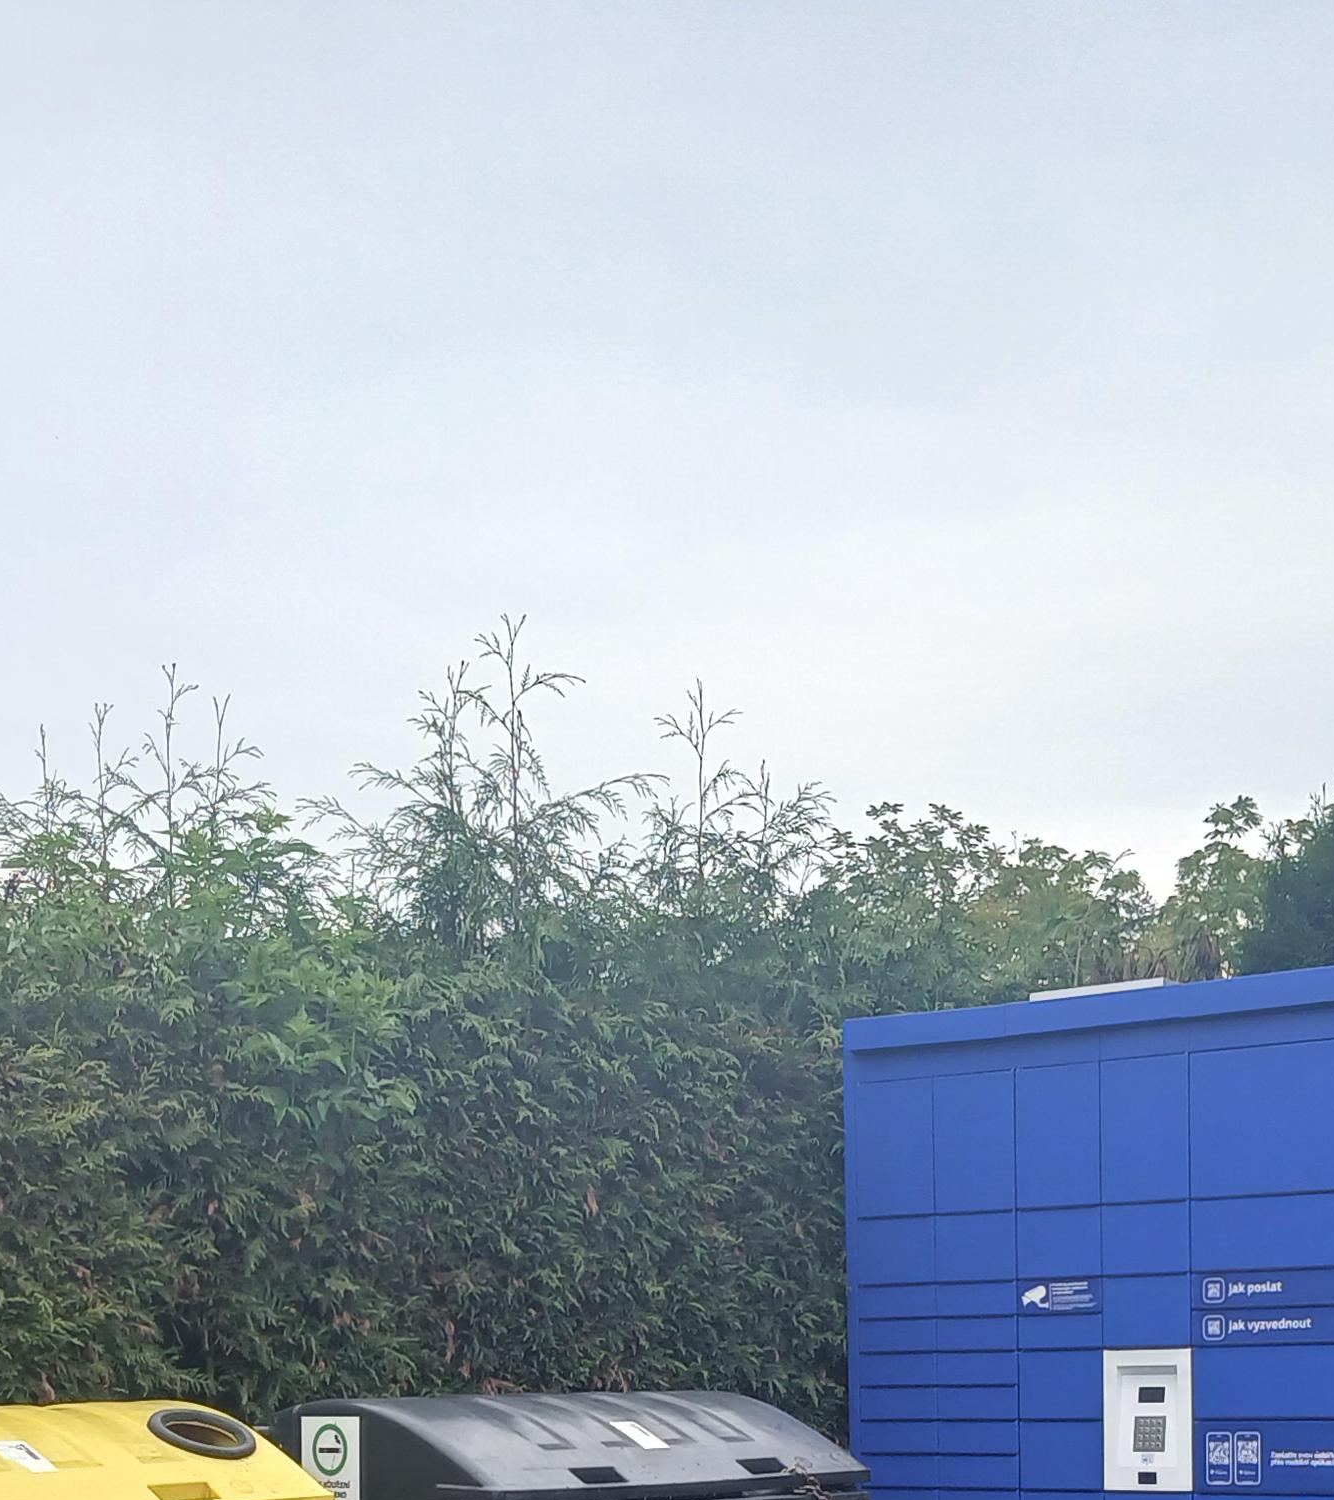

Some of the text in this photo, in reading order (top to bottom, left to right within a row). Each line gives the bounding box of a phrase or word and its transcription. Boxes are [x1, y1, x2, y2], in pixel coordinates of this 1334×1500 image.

[1228, 1281, 1282, 1296] Jak poslat
[1228, 1317, 1312, 1334] Jak vyzvednout
